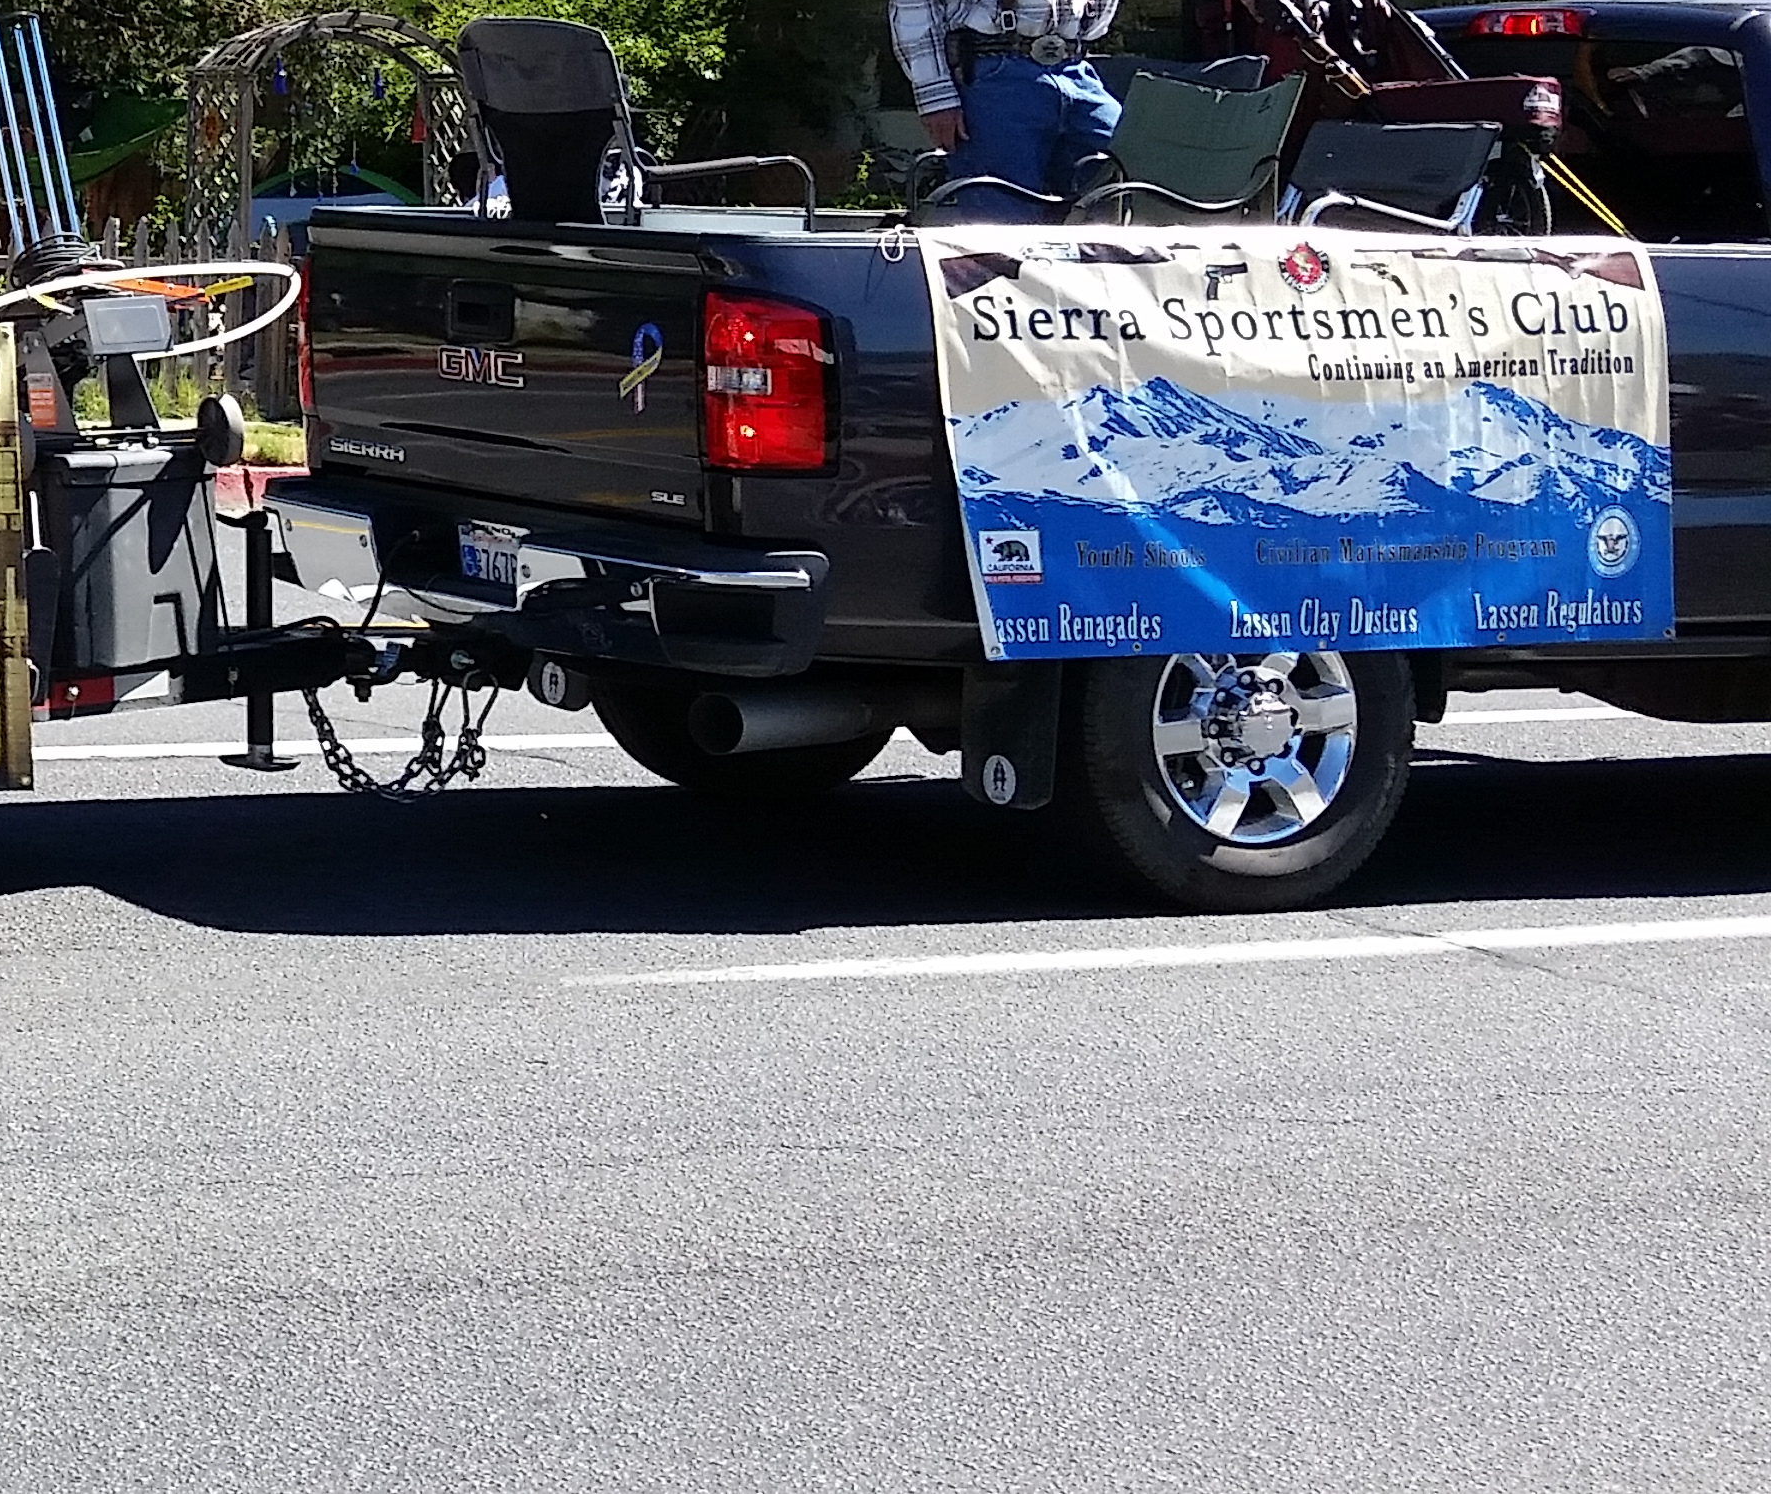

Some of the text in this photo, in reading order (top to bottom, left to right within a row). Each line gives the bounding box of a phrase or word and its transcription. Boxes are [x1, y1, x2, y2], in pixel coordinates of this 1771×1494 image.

[972, 290, 1628, 356] Sierra Sportsmen's Club
[438, 345, 524, 388] GMC
[1309, 348, 1633, 384] Continuing an American Tradition
[330, 438, 405, 463] SIERRA
[651, 491, 685, 505] SLE
[1075, 541, 1134, 567] Youth
[1255, 538, 1330, 565] Civilian
[1338, 535, 1468, 566] Marksmanship
[1475, 532, 1556, 561] Program
[995, 602, 1161, 647] assen Renagades
[1230, 596, 1418, 641] Lassen Clay Dusters
[1473, 589, 1643, 631] Lassen Regulators
